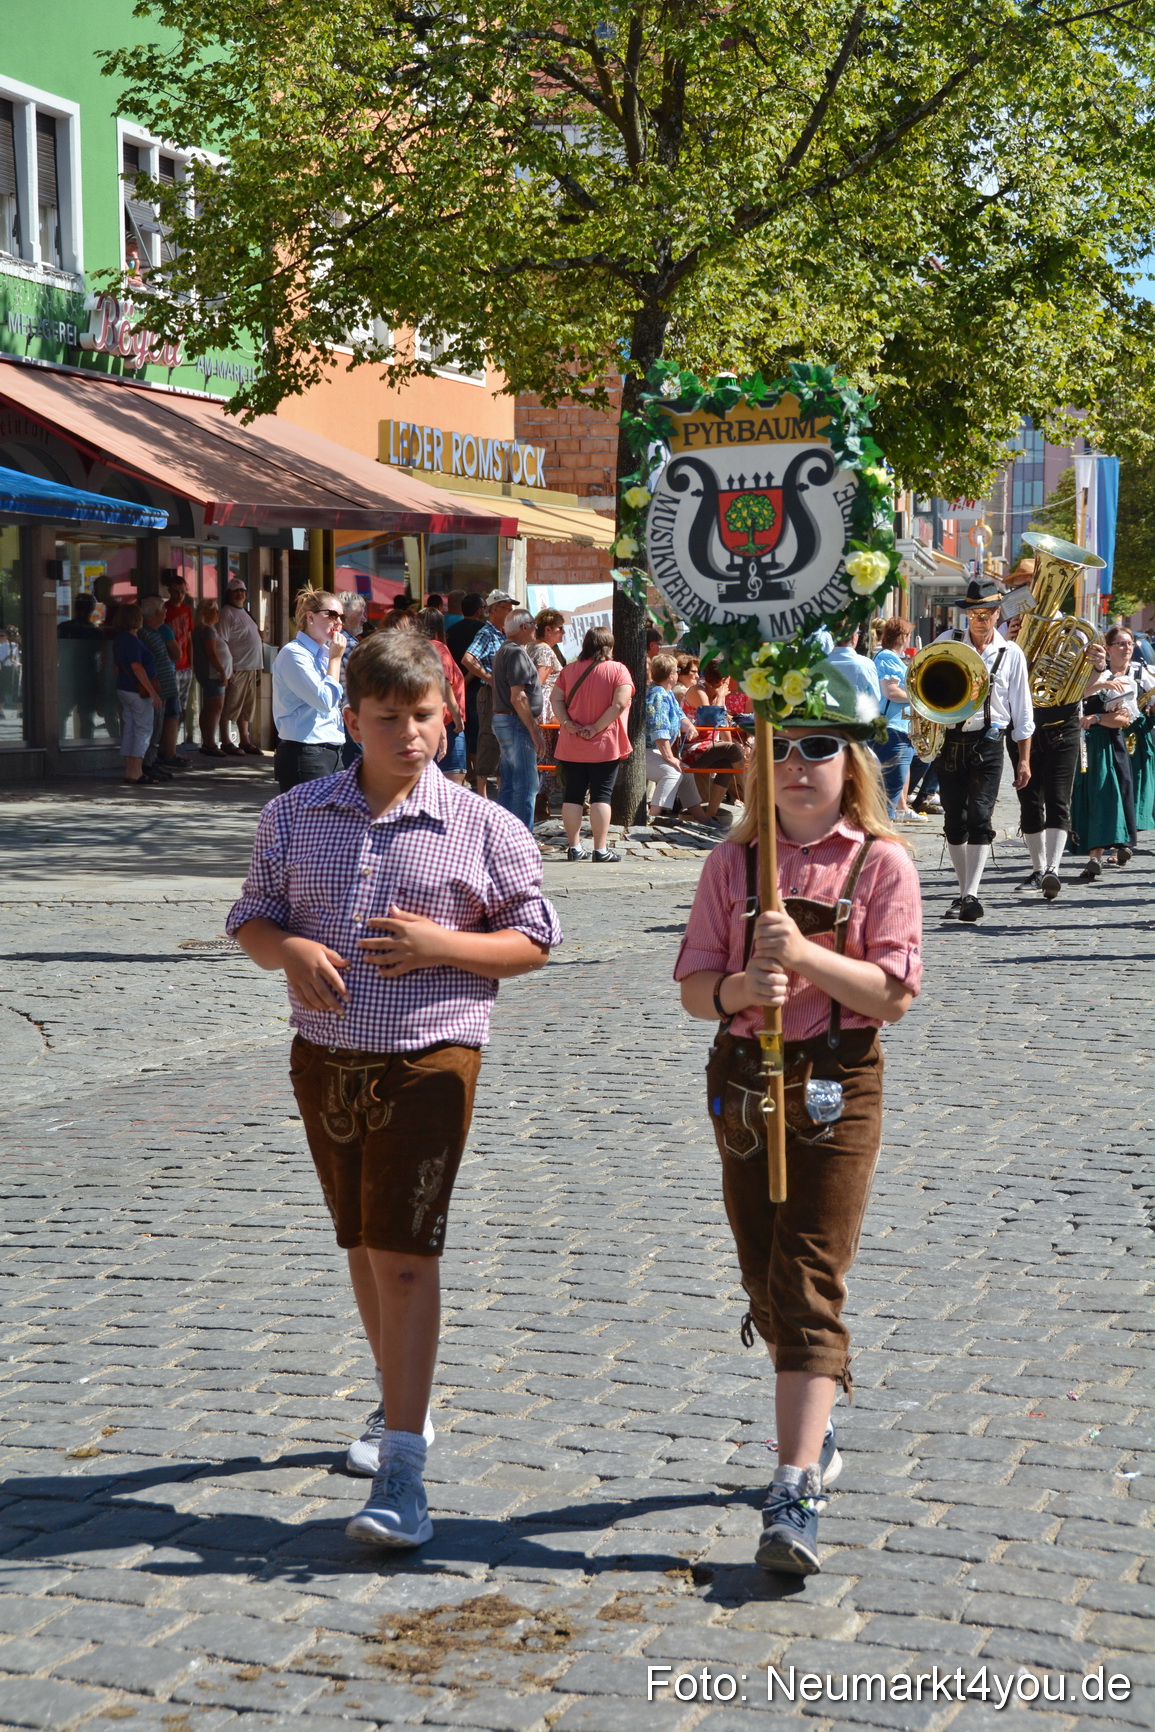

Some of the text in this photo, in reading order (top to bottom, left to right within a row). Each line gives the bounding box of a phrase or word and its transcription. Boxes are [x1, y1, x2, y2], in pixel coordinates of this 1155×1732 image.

[8, 310, 77, 346] METZGEREI
[196, 355, 213, 375] AM
[682, 416, 817, 447] PYRBAUM
[388, 419, 547, 488] LEDER ROMSTÖCK
[650, 491, 717, 625] MUSIKVEREIN
